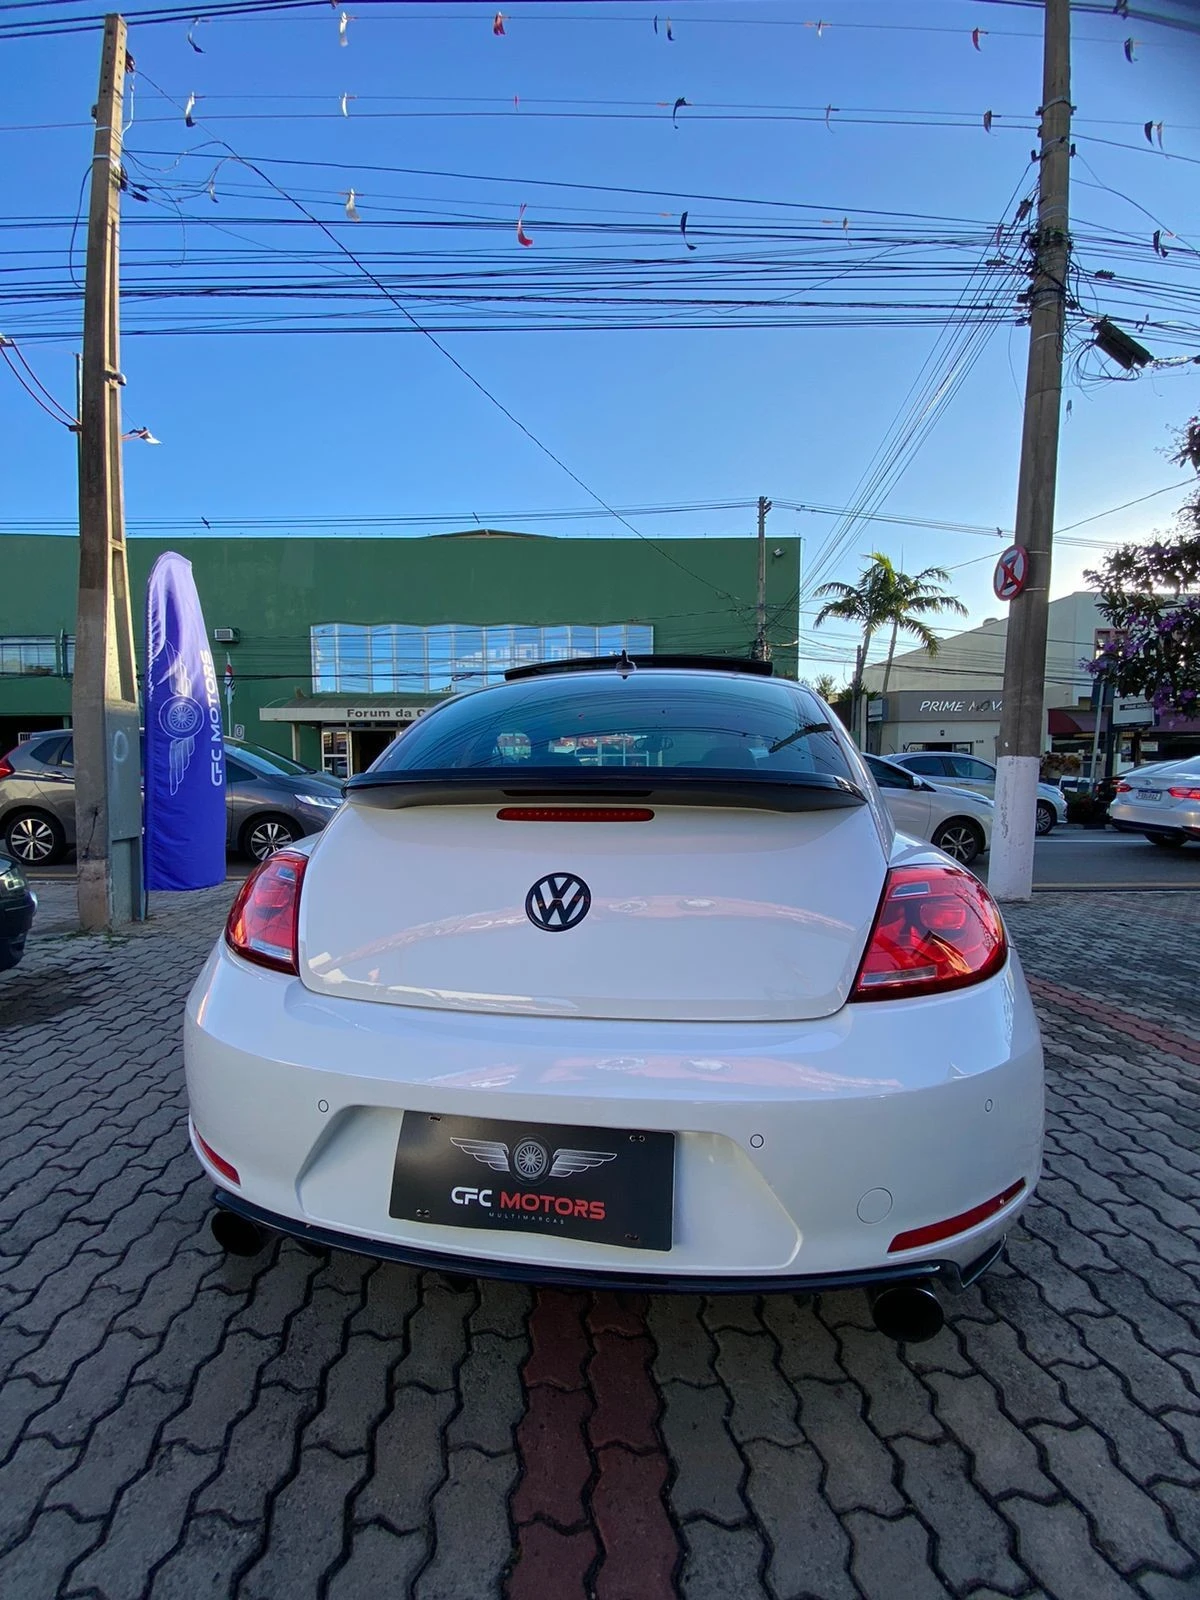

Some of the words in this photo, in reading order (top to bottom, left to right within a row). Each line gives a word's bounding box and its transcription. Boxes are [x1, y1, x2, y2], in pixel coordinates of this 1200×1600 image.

[200, 649, 221, 742] MOTORS
[919, 700, 966, 712] PRIME
[347, 709, 390, 718] Forum
[395, 709, 412, 718] da
[211, 749, 223, 786] CFC
[451, 1186, 493, 1207] CFC
[500, 1191, 606, 1221] MOTORS
[489, 1212, 565, 1225] MULTIMARCAS
